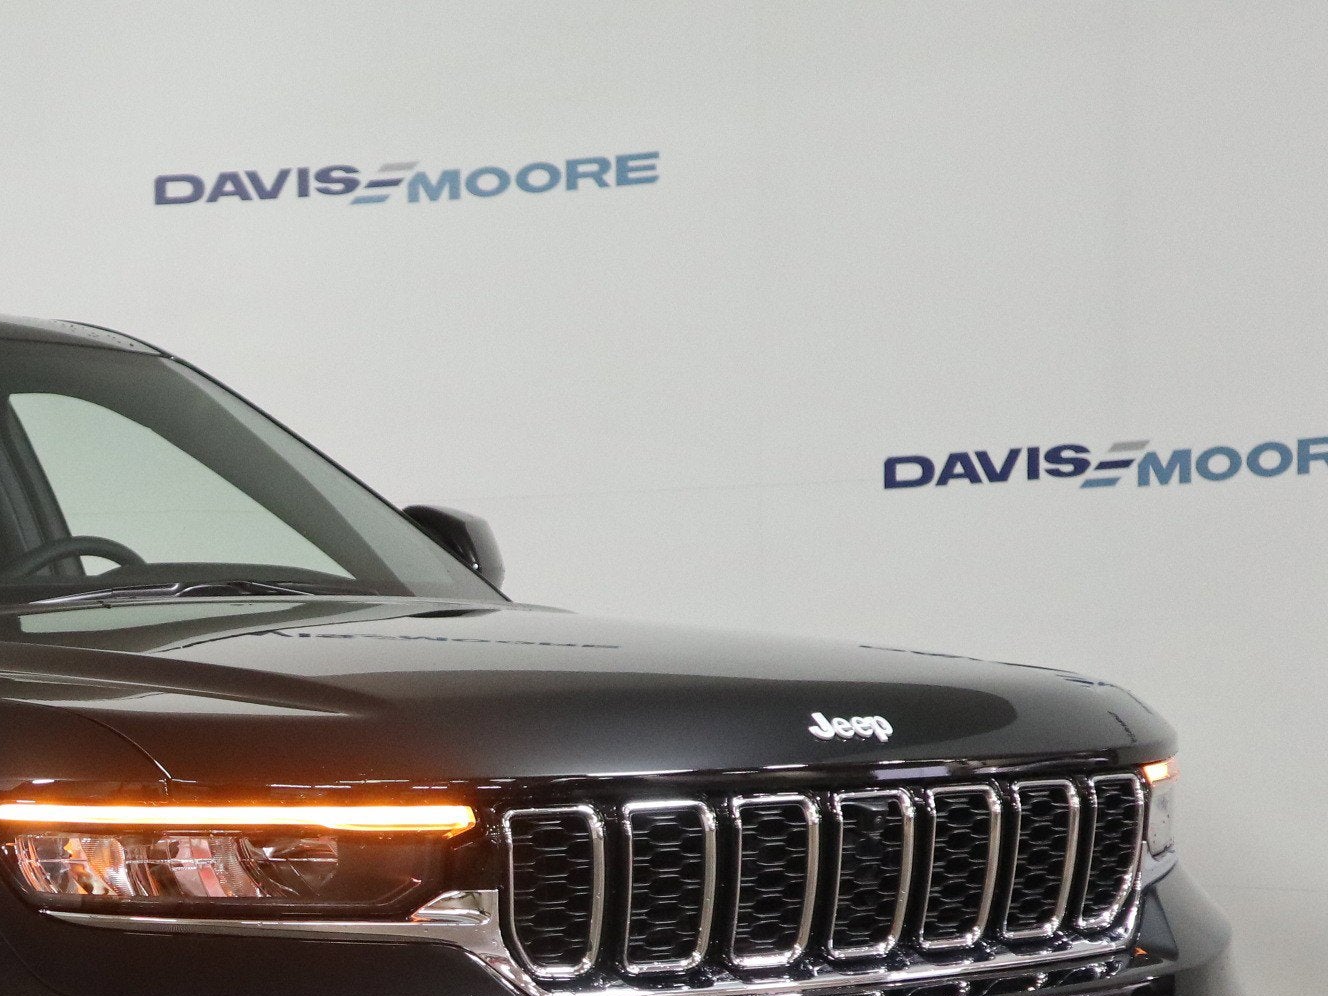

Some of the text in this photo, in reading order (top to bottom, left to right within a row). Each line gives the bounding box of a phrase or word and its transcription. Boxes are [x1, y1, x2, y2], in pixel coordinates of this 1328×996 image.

[154, 151, 660, 206] DAVIS MOORE
[883, 443, 1092, 490] DAVIS
[808, 711, 894, 743] Jeep
